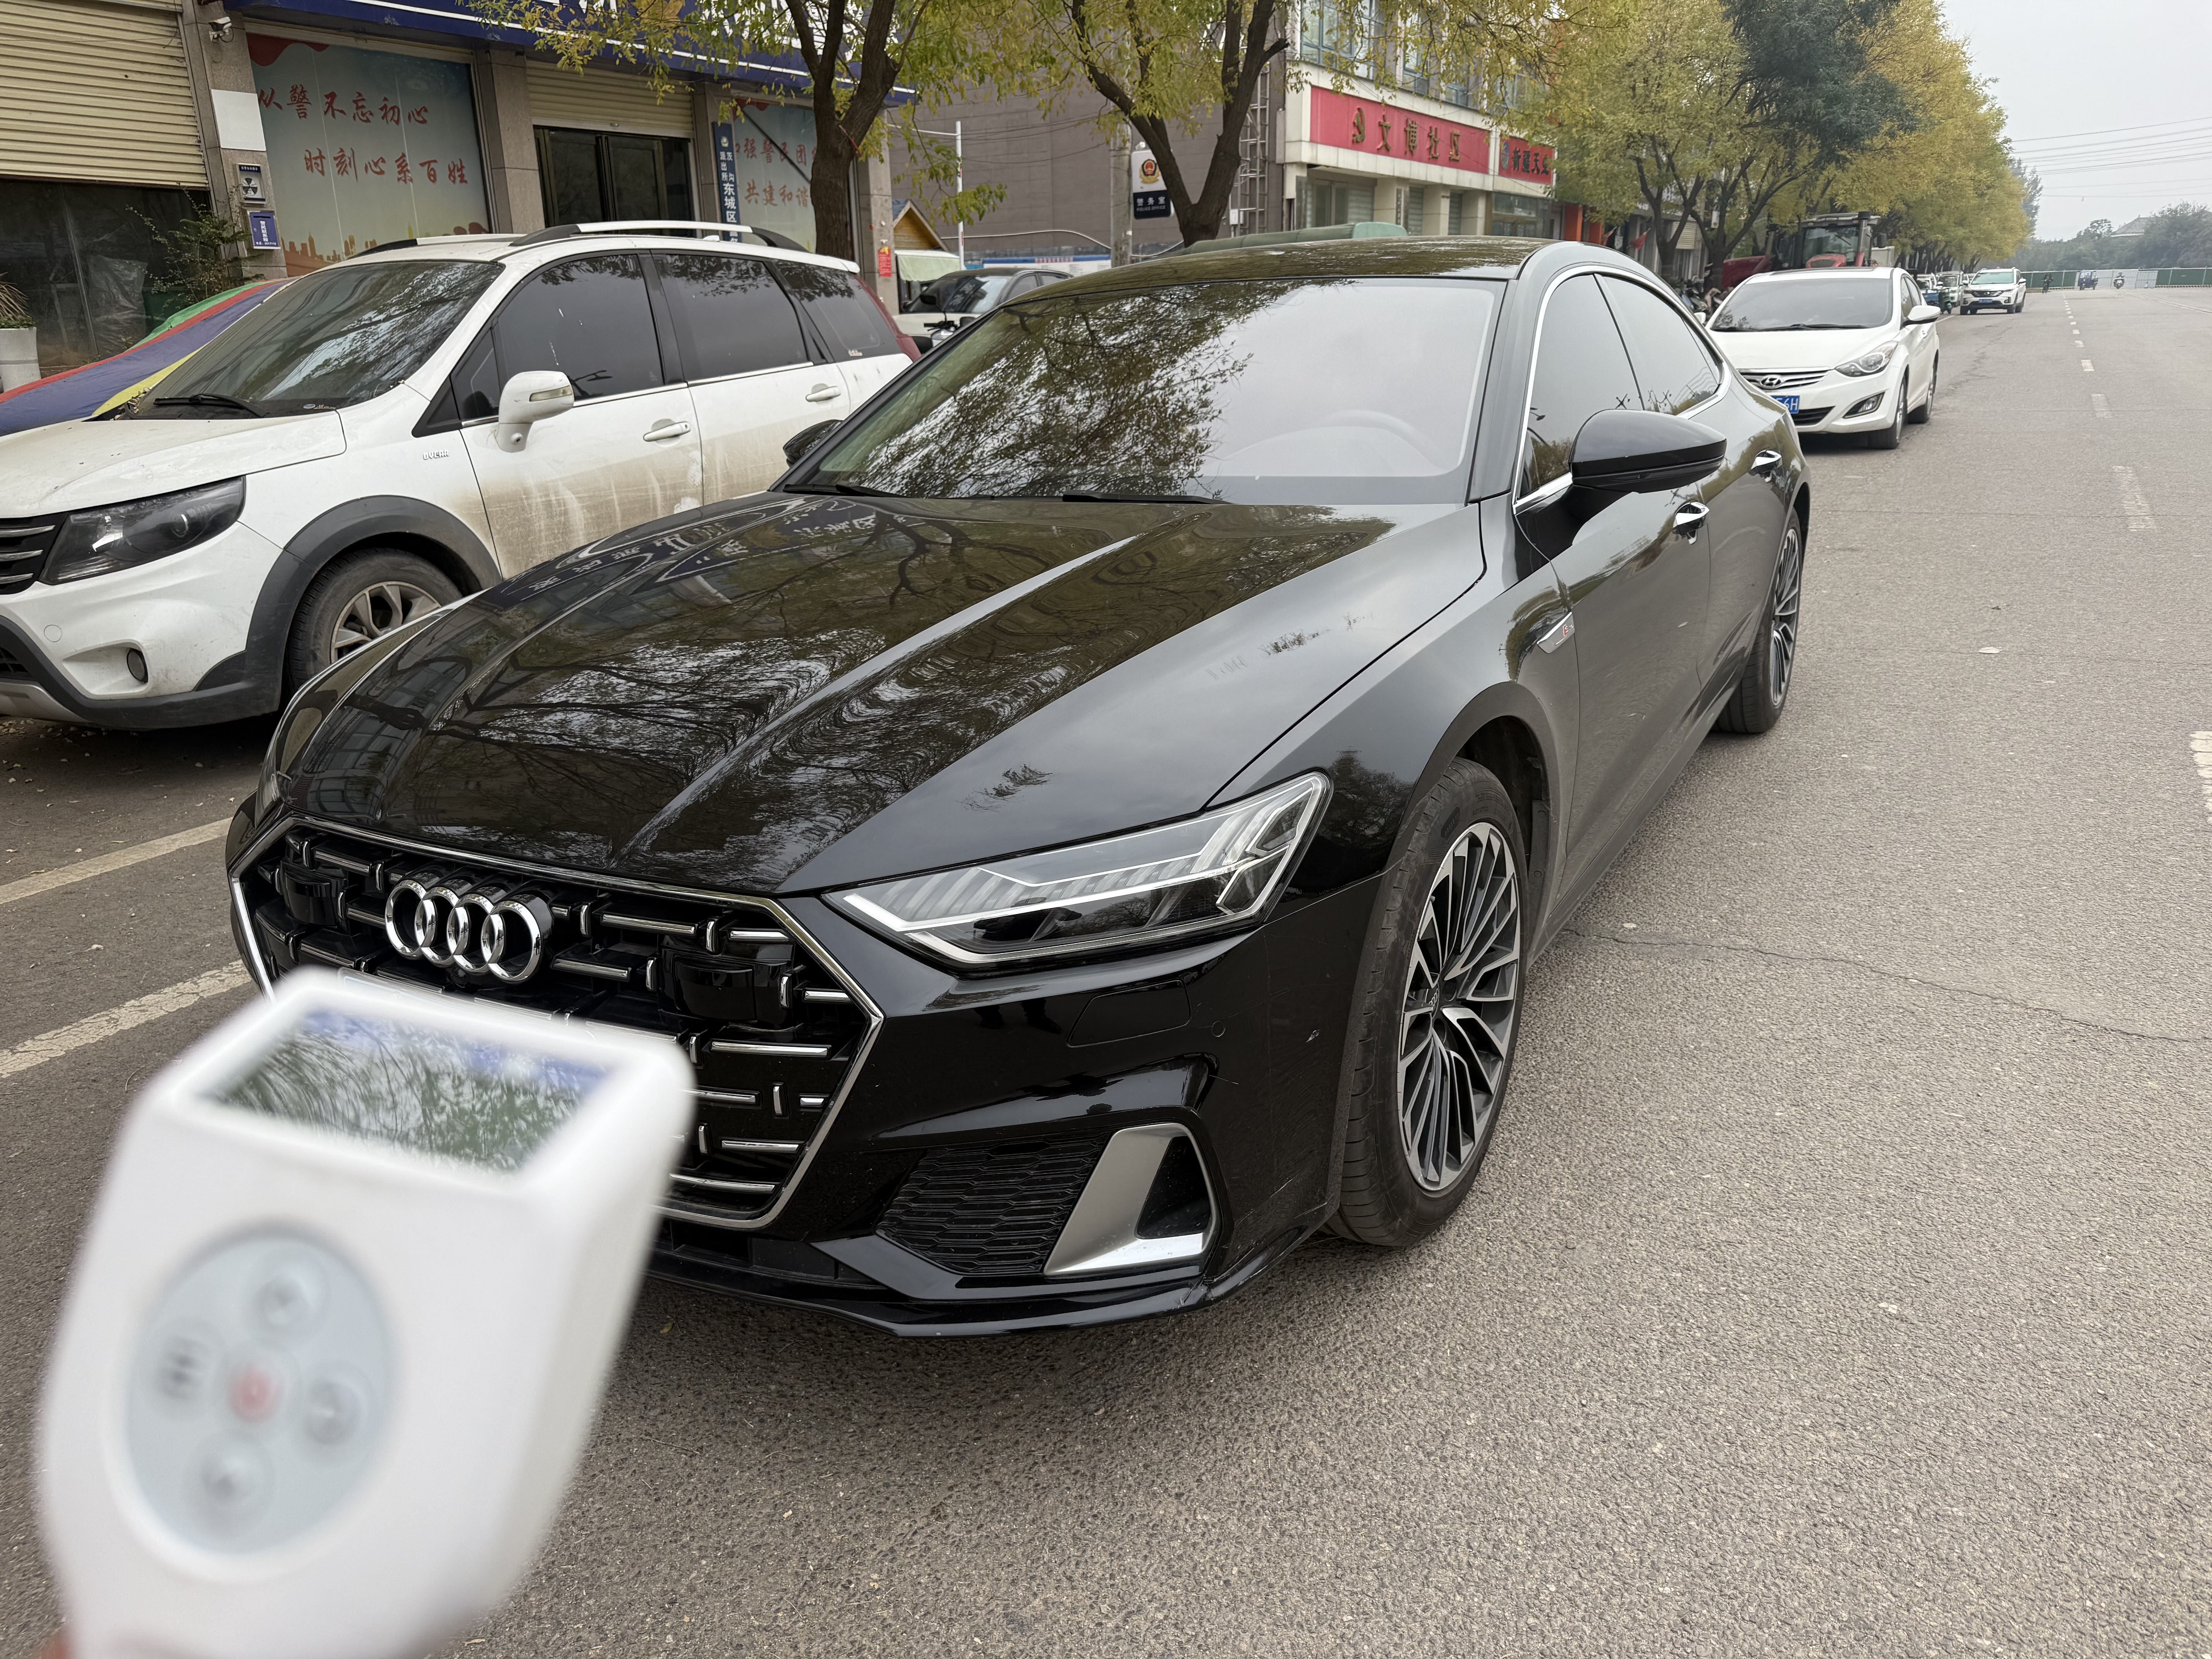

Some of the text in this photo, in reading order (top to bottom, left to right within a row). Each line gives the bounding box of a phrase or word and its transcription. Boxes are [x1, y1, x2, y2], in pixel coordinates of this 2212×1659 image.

[258, 84, 428, 125] 从警不忘初心
[1377, 114, 1461, 161] 文博社区
[304, 148, 468, 184] 时刻心系百姓
[1776, 398, 1798, 410] 6H
